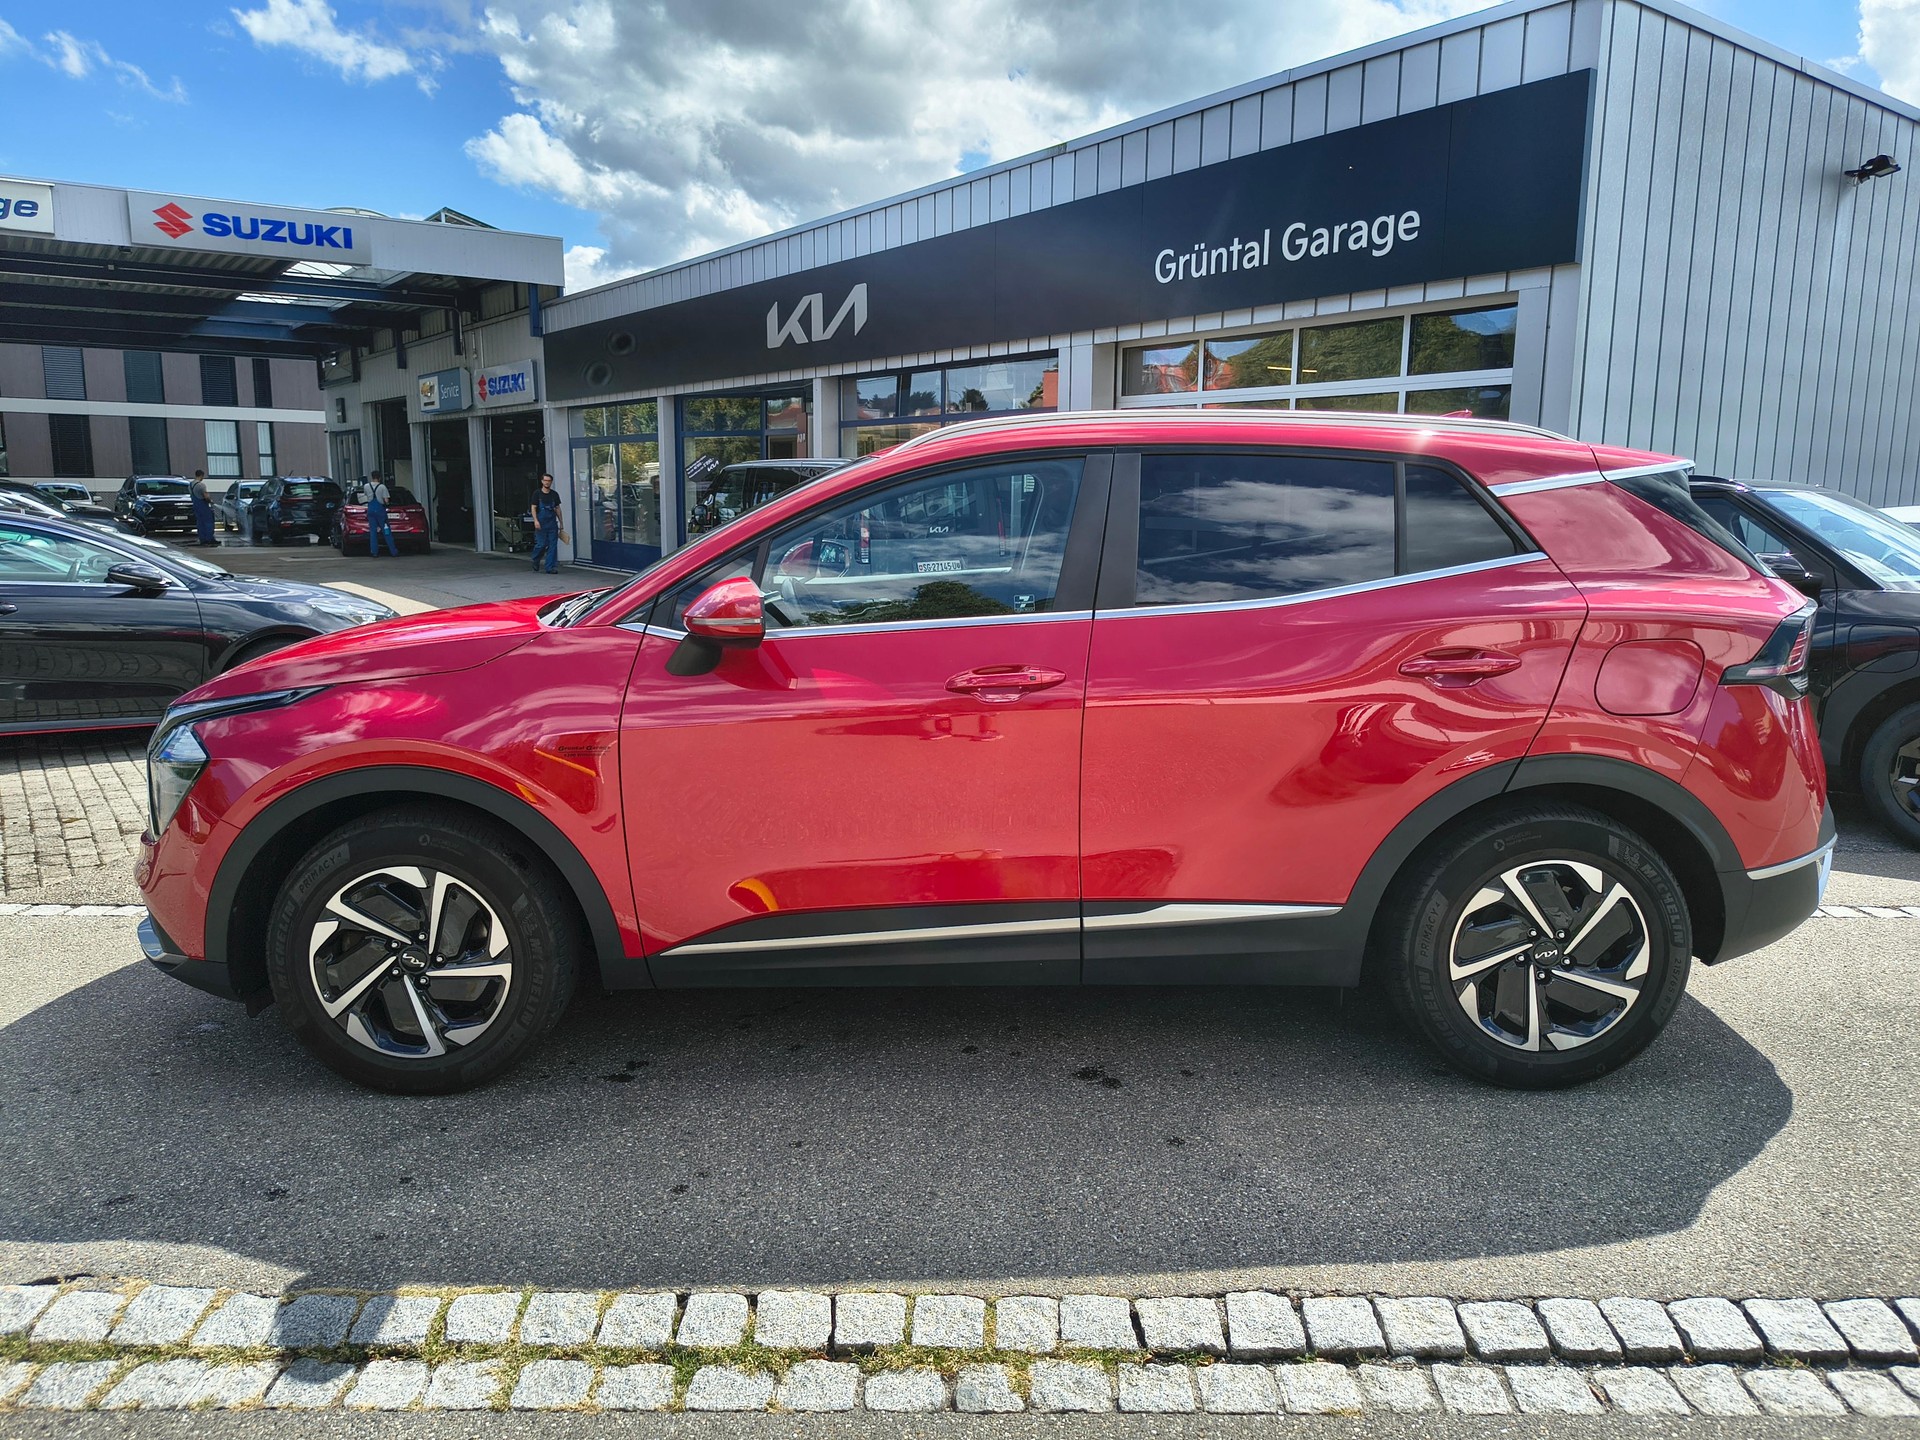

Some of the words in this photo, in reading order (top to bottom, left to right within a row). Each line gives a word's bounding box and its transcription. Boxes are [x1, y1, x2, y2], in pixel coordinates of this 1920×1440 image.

[202, 212, 353, 250] SUZUKI
[1154, 228, 1271, 284] Grüntal
[1281, 210, 1421, 262] Garage
[766, 282, 868, 349] KIA
[441, 382, 460, 400] Service
[487, 372, 526, 396] SUZUKI
[929, 525, 949, 533] KIA
[300, 857, 336, 893] PRIMACY
[1640, 863, 1684, 947] MICHELIN
[275, 900, 297, 990] MICHELIN
[1420, 908, 1439, 957] PRIMACY
[527, 936, 546, 1027] MICHELIN
